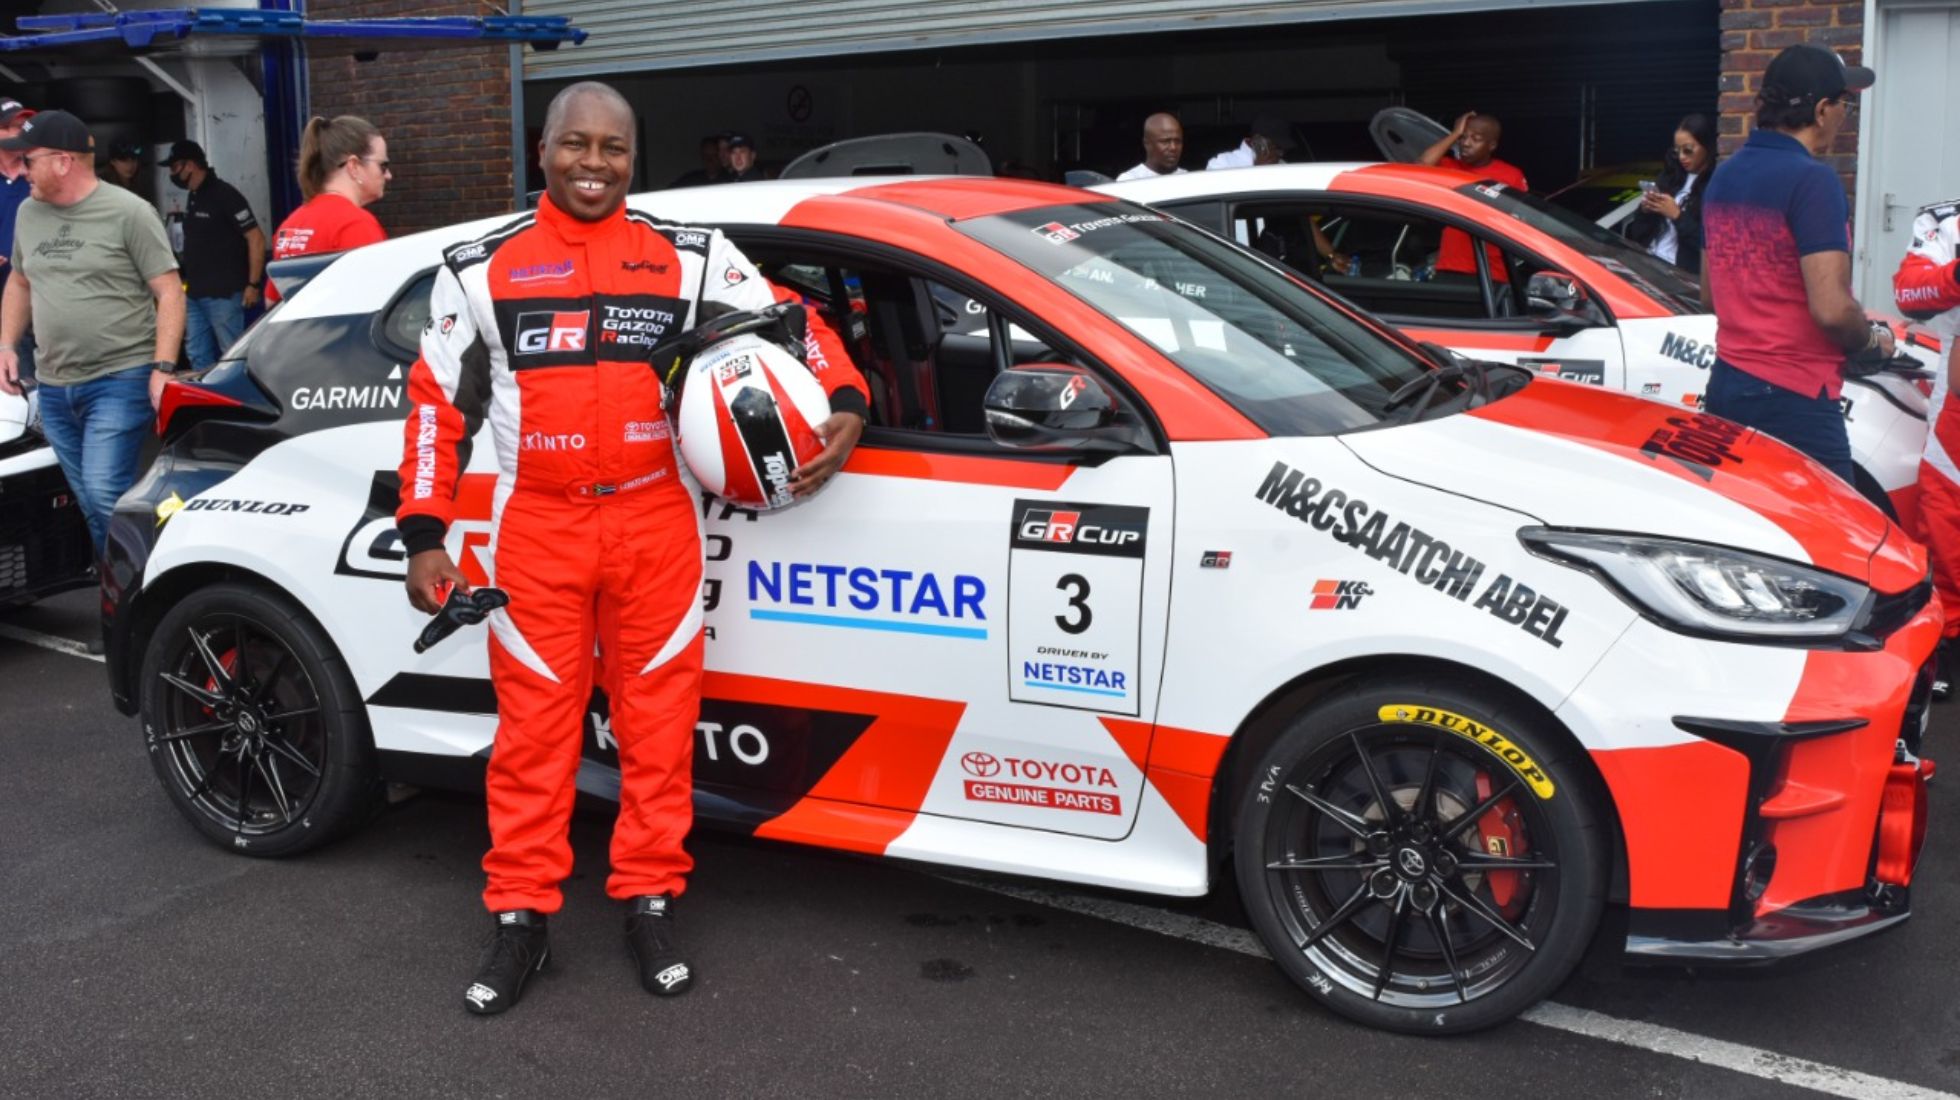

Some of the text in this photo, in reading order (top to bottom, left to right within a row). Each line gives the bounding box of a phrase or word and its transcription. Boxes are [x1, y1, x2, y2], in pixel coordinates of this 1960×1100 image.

[677, 233, 705, 247] OMP
[456, 246, 486, 262] OMP
[603, 319, 665, 334] GAZOO
[604, 306, 674, 324] TOYOTA
[517, 326, 588, 351] GR
[601, 330, 658, 349] Racing
[291, 386, 402, 410] GARMIN
[1060, 375, 1087, 410] GR
[183, 499, 310, 516] DUNLOP
[1021, 521, 1140, 545] GR CUP
[1255, 461, 1570, 648] M&CSAATCHI ABEL
[748, 560, 987, 620] NETSTAR
[1055, 573, 1092, 634] 3
[1037, 646, 1109, 660] DRIVEN BY
[1024, 661, 1126, 690] NETSTAR
[1416, 707, 1545, 786] DUNLOP
[1005, 758, 1118, 788] TOYOTA
[972, 784, 1113, 812] GENUINE PARTS
[658, 965, 690, 985] OMP
[466, 985, 494, 1001] OMP
